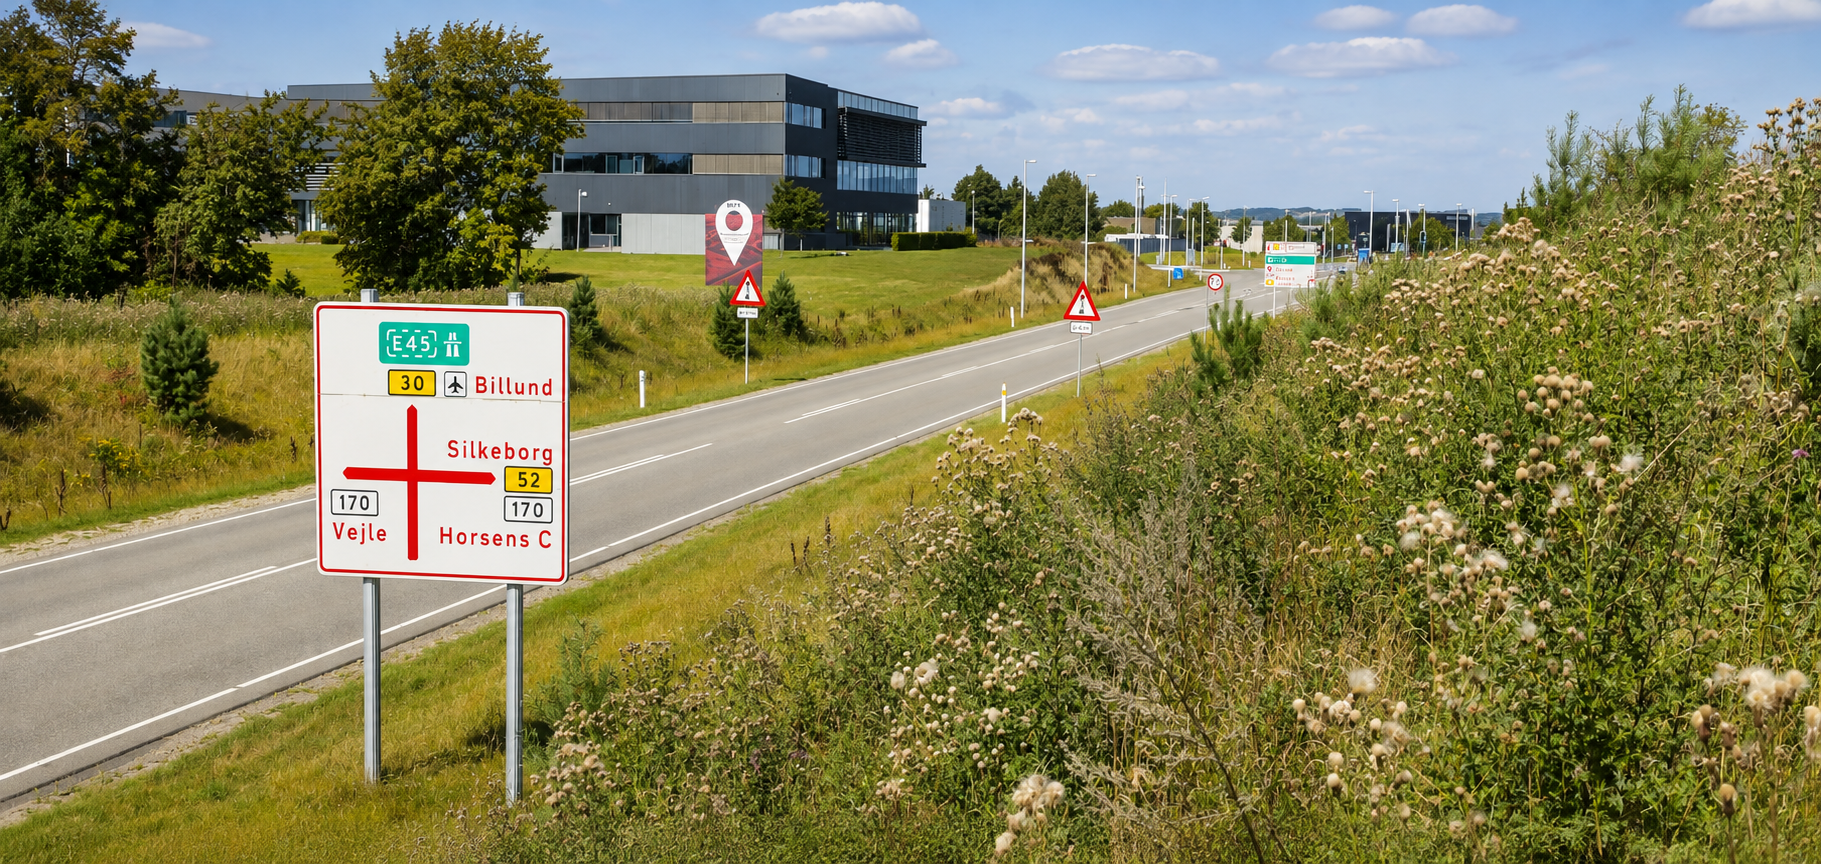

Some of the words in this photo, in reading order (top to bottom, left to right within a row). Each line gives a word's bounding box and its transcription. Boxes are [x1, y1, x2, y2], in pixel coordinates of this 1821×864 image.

[393, 336, 430, 352] E45
[401, 375, 424, 391] 30
[475, 376, 552, 396] Billund
[447, 440, 553, 465] Silkeborg
[518, 472, 540, 488] 52
[339, 494, 370, 510] 170
[512, 502, 543, 518] 170
[333, 522, 387, 544] Vejle
[439, 527, 529, 547] Horsens
[538, 530, 552, 548] C
